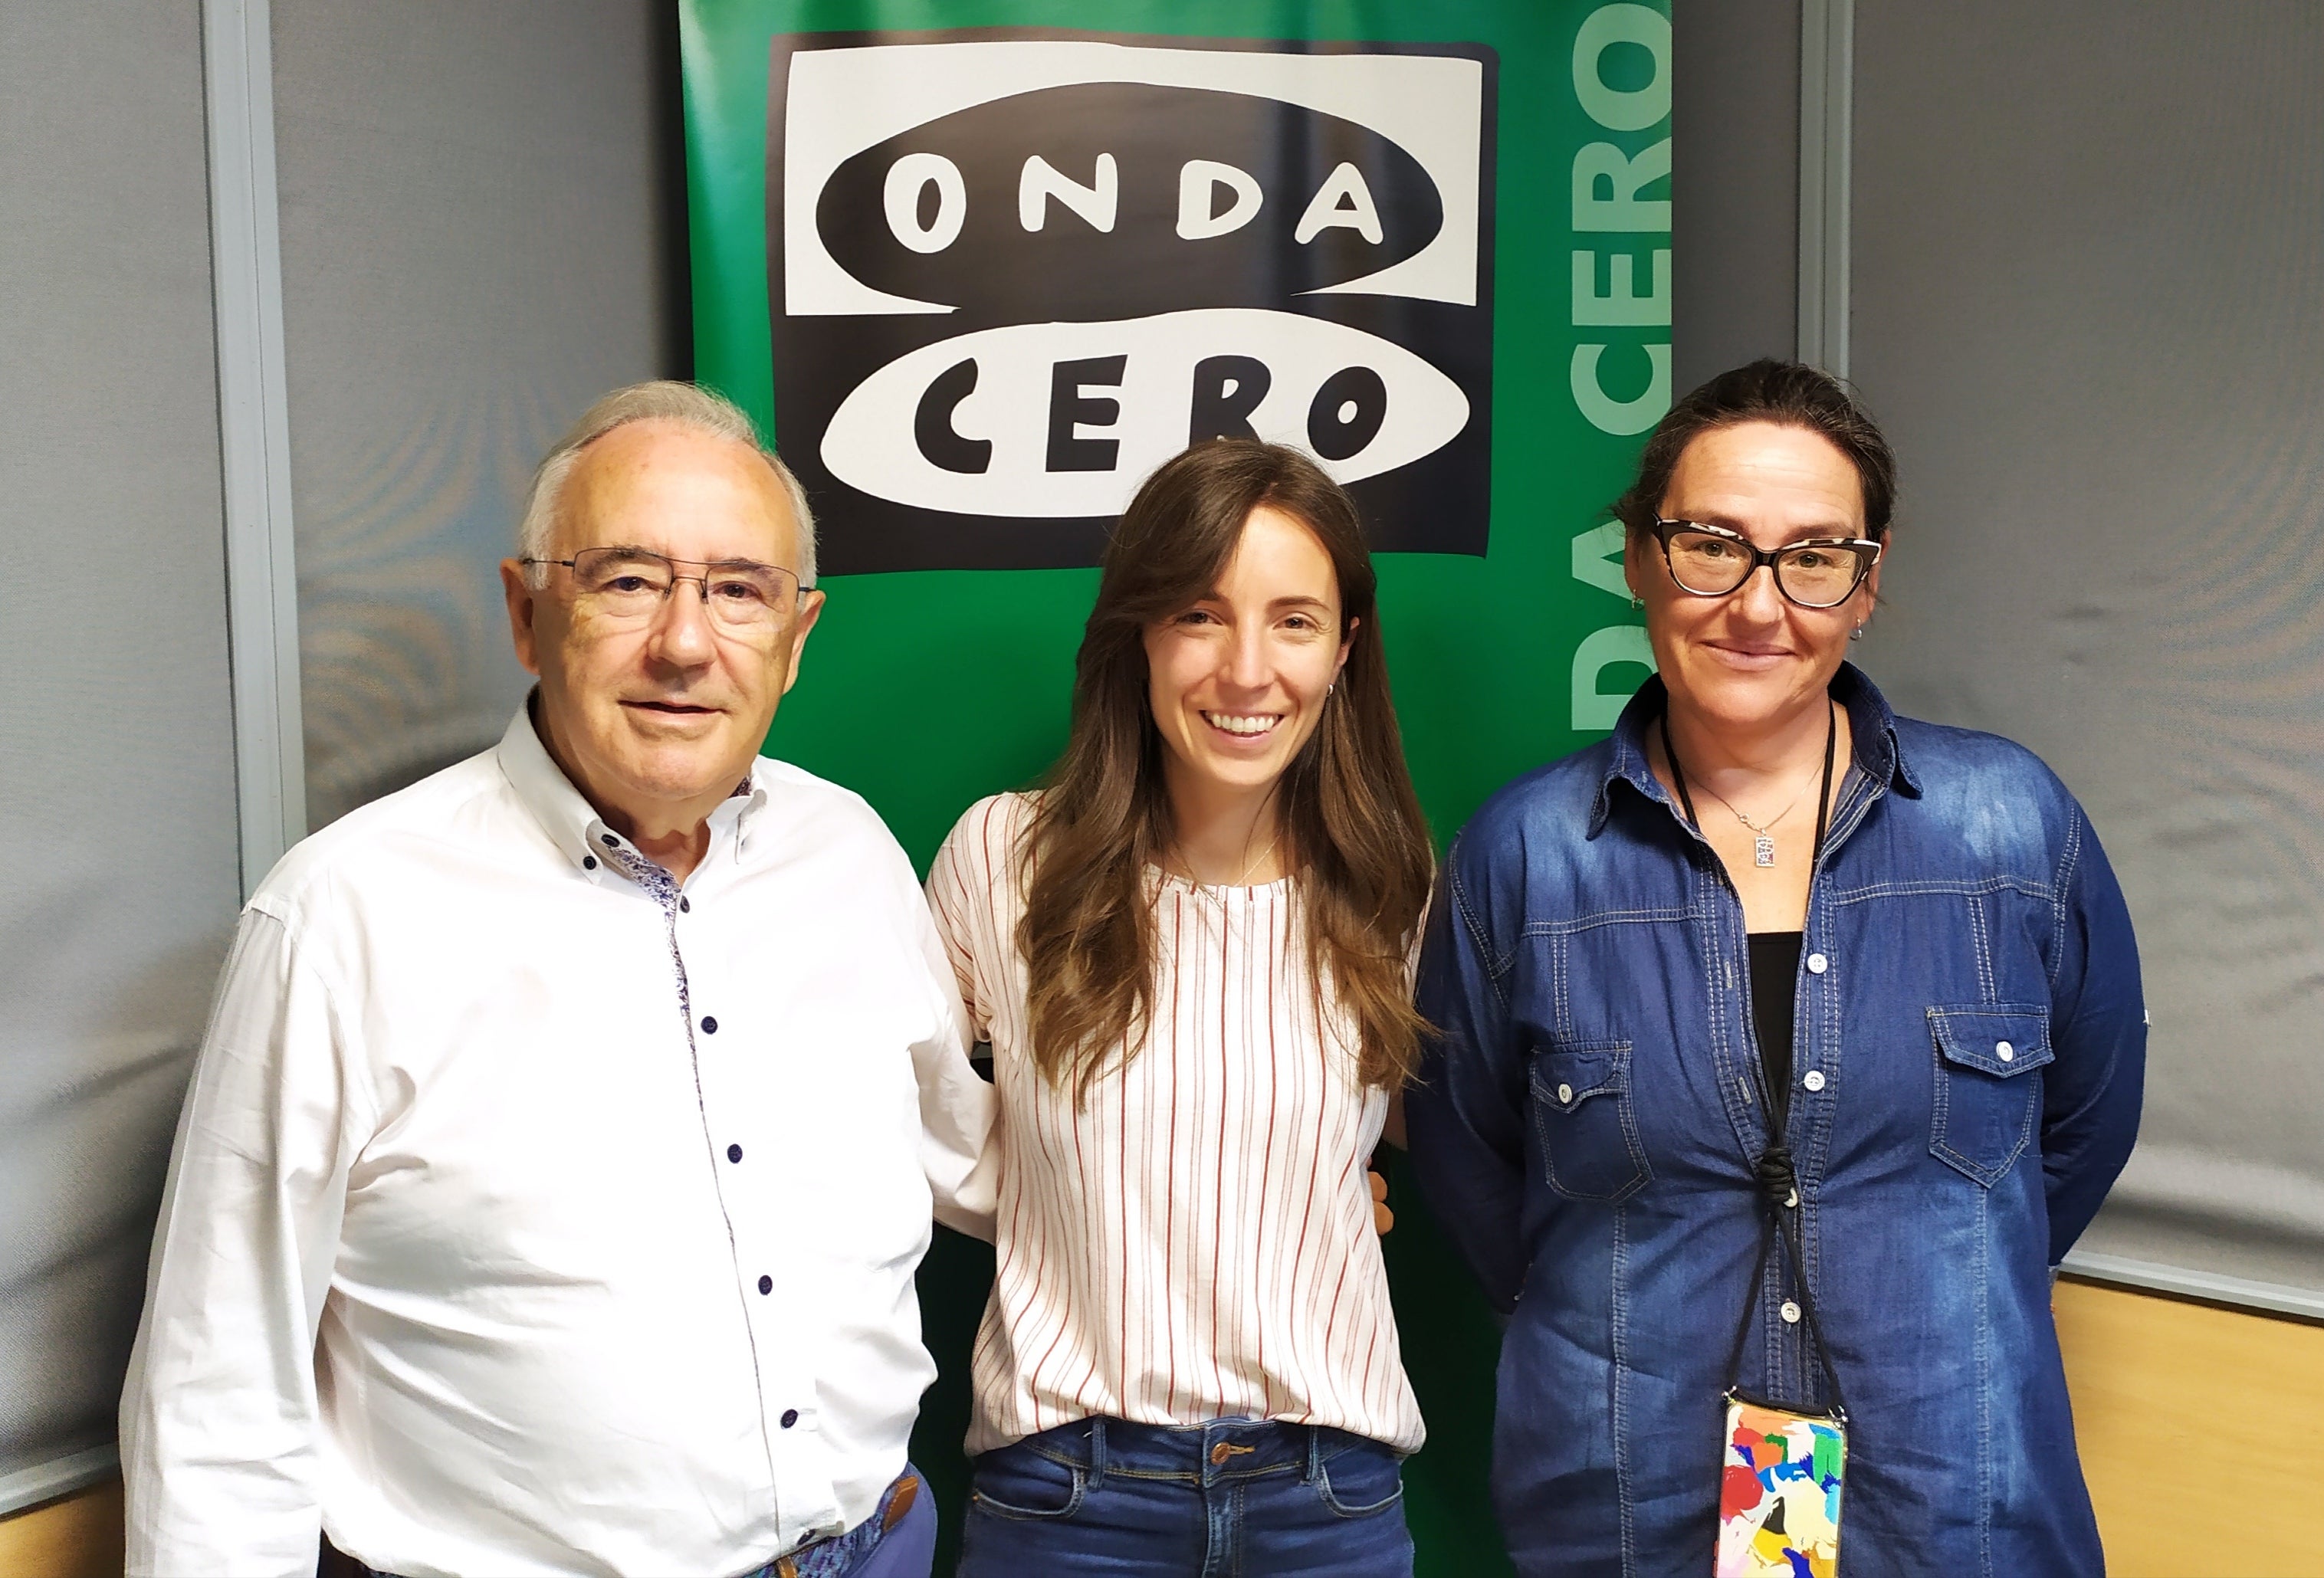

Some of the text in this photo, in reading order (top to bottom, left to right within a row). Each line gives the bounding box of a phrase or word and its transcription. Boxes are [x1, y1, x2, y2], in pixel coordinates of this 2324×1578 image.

[885, 153, 1383, 253] ONDA
[1571, 2, 1672, 435] CERO
[914, 354, 1387, 474] CERO
